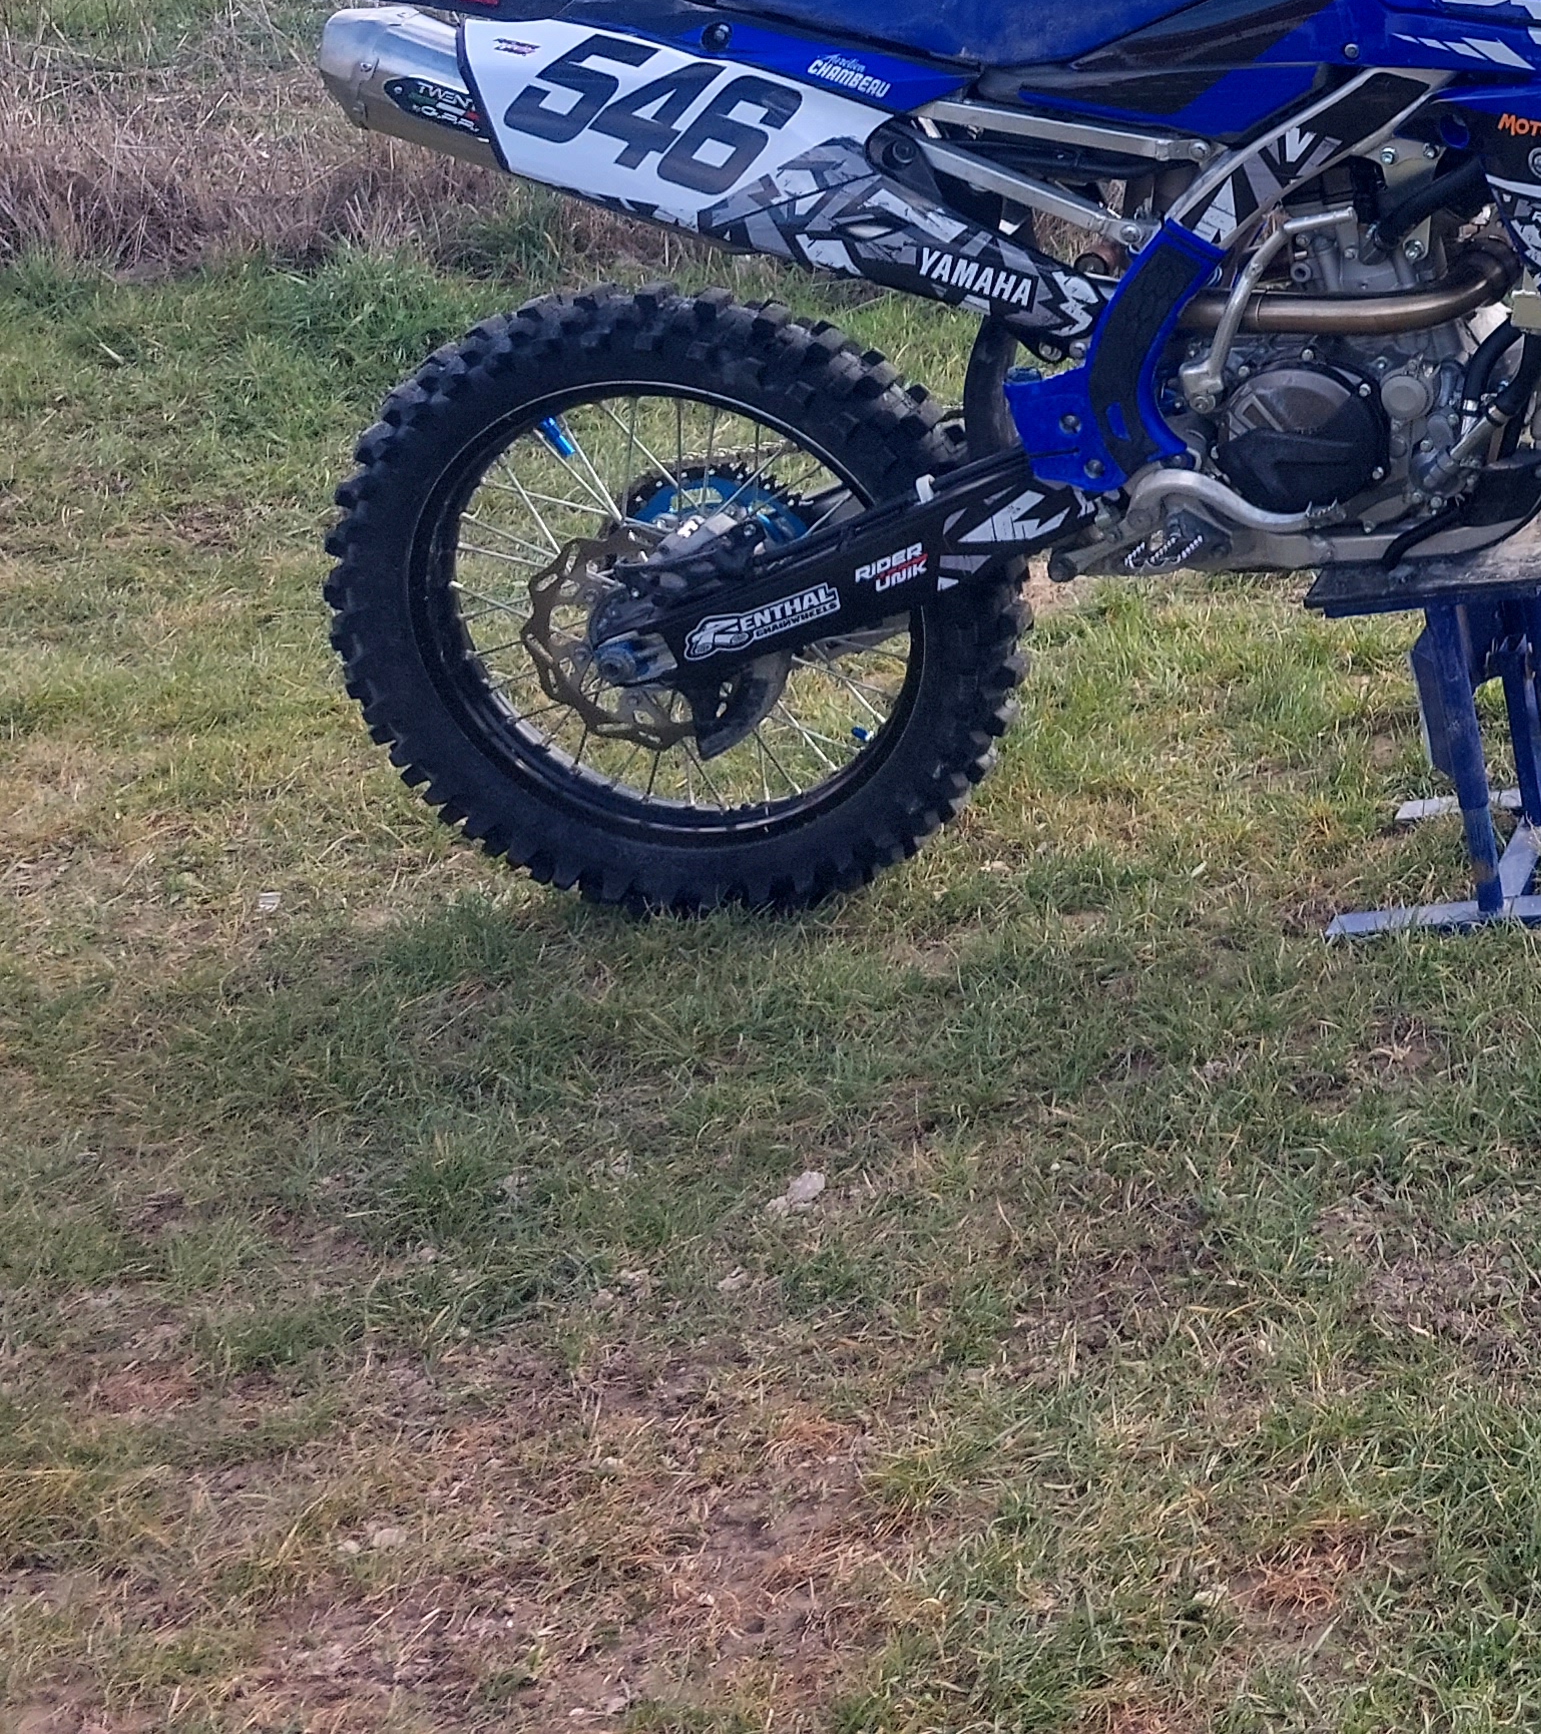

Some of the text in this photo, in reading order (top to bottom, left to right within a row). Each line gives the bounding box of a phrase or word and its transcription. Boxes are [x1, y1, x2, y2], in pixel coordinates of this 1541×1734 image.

[807, 58, 891, 99] CHAMBEAU
[500, 31, 804, 198] 546
[918, 246, 1033, 307] YAMAHA
[854, 541, 924, 584] RIDER
[874, 559, 928, 593] UNIK
